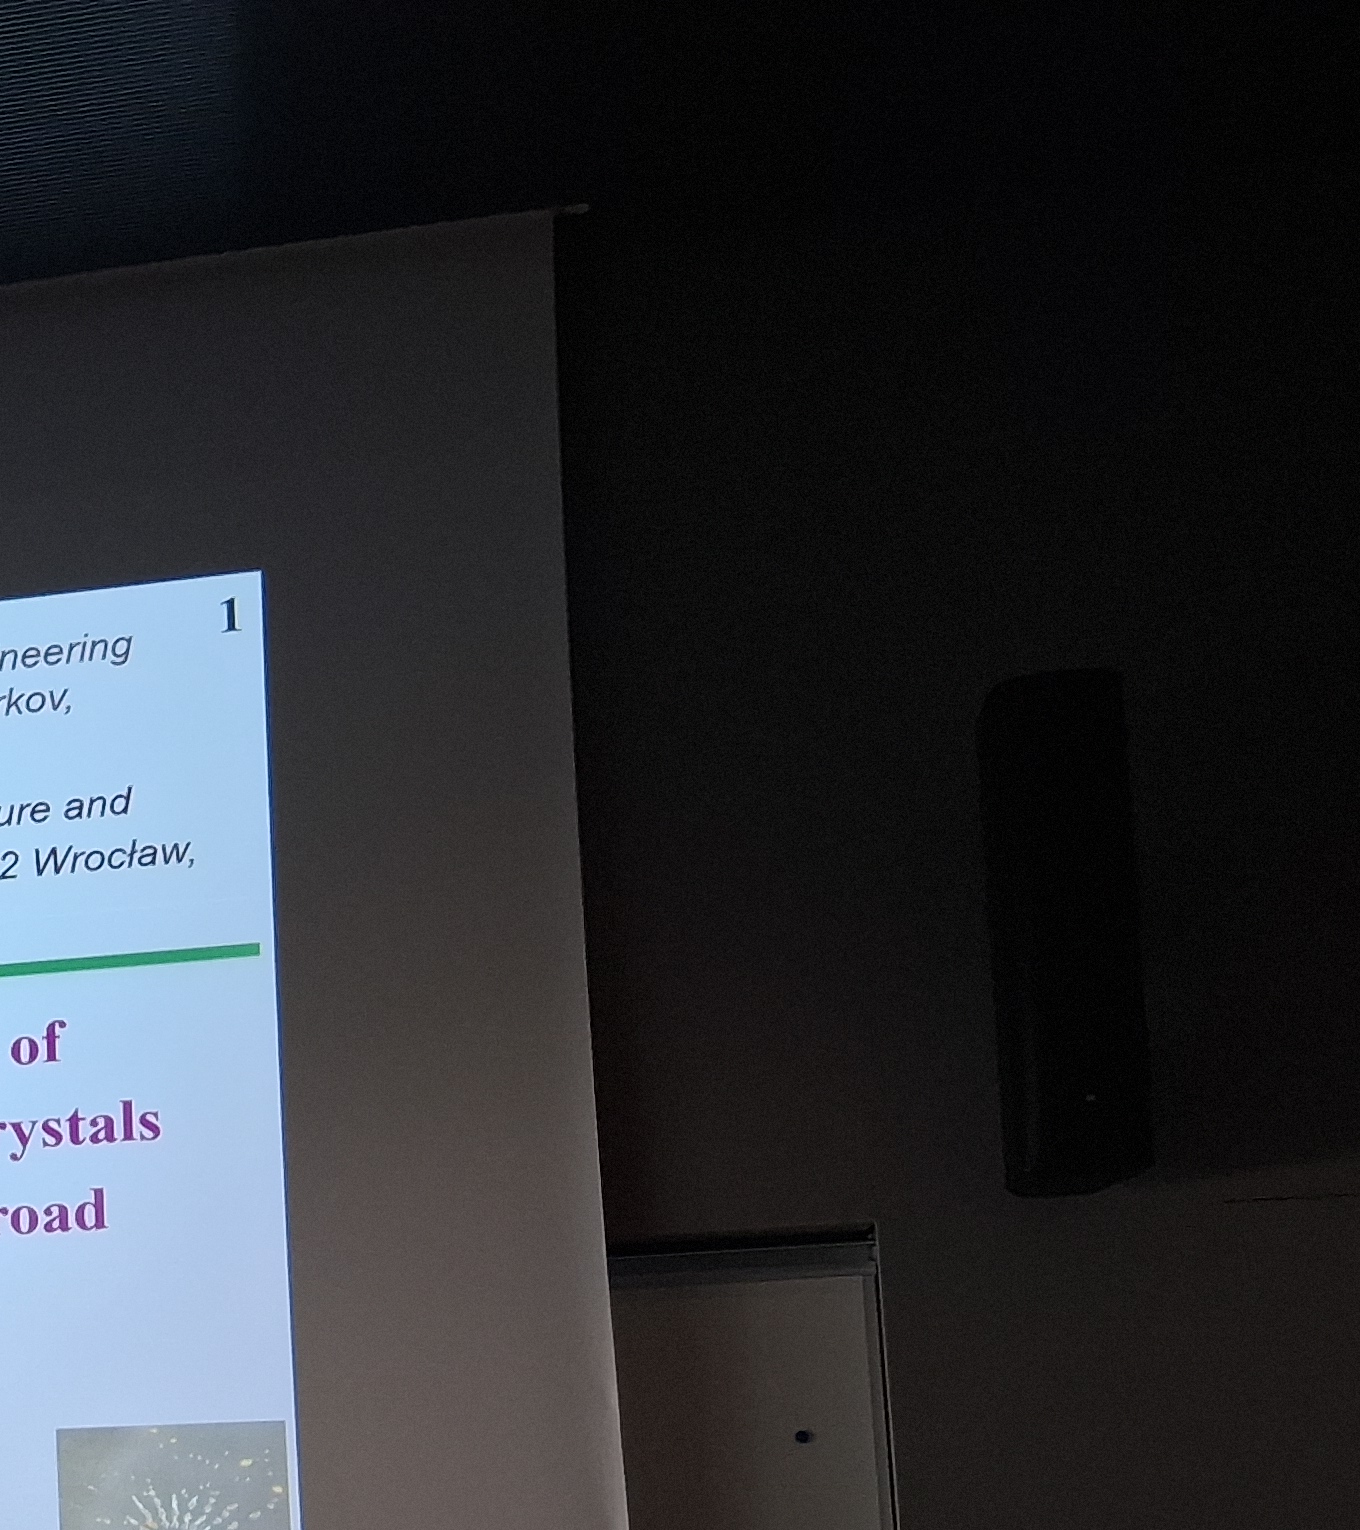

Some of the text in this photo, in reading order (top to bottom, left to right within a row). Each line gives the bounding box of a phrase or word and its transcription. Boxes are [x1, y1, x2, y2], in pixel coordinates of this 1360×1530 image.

[219, 595, 243, 634] 1
[62, 784, 135, 821] and
[33, 837, 195, 878] Wrocław,
[11, 1020, 67, 1064] of
